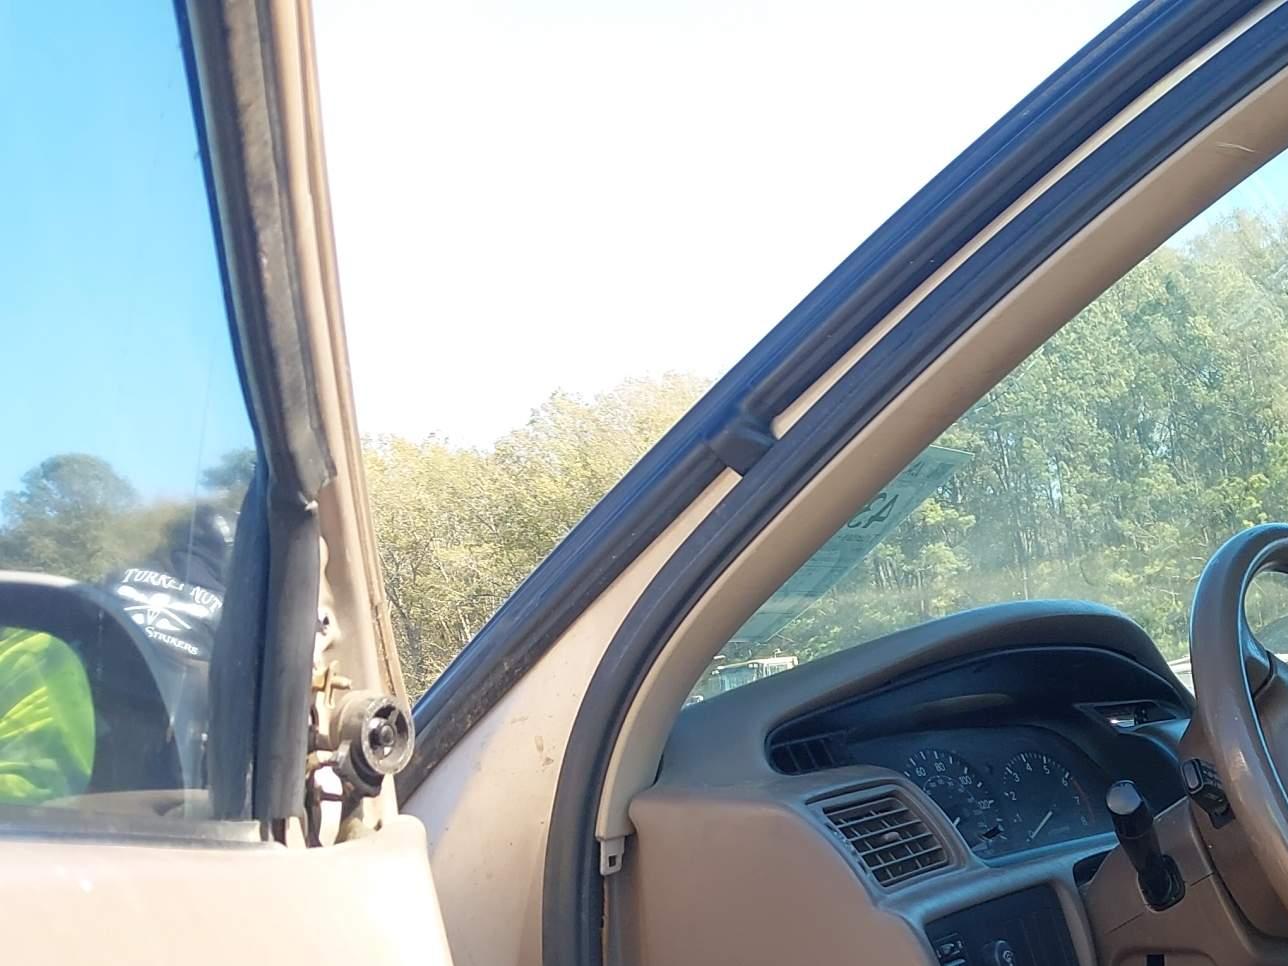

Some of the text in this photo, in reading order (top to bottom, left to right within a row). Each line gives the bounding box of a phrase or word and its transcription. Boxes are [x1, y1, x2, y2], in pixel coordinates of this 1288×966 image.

[1026, 762, 1033, 772] 4
[1042, 765, 1050, 775] 5
[960, 775, 973, 785] 100
[1012, 772, 1020, 783] 3
[1009, 791, 1017, 801] 2
